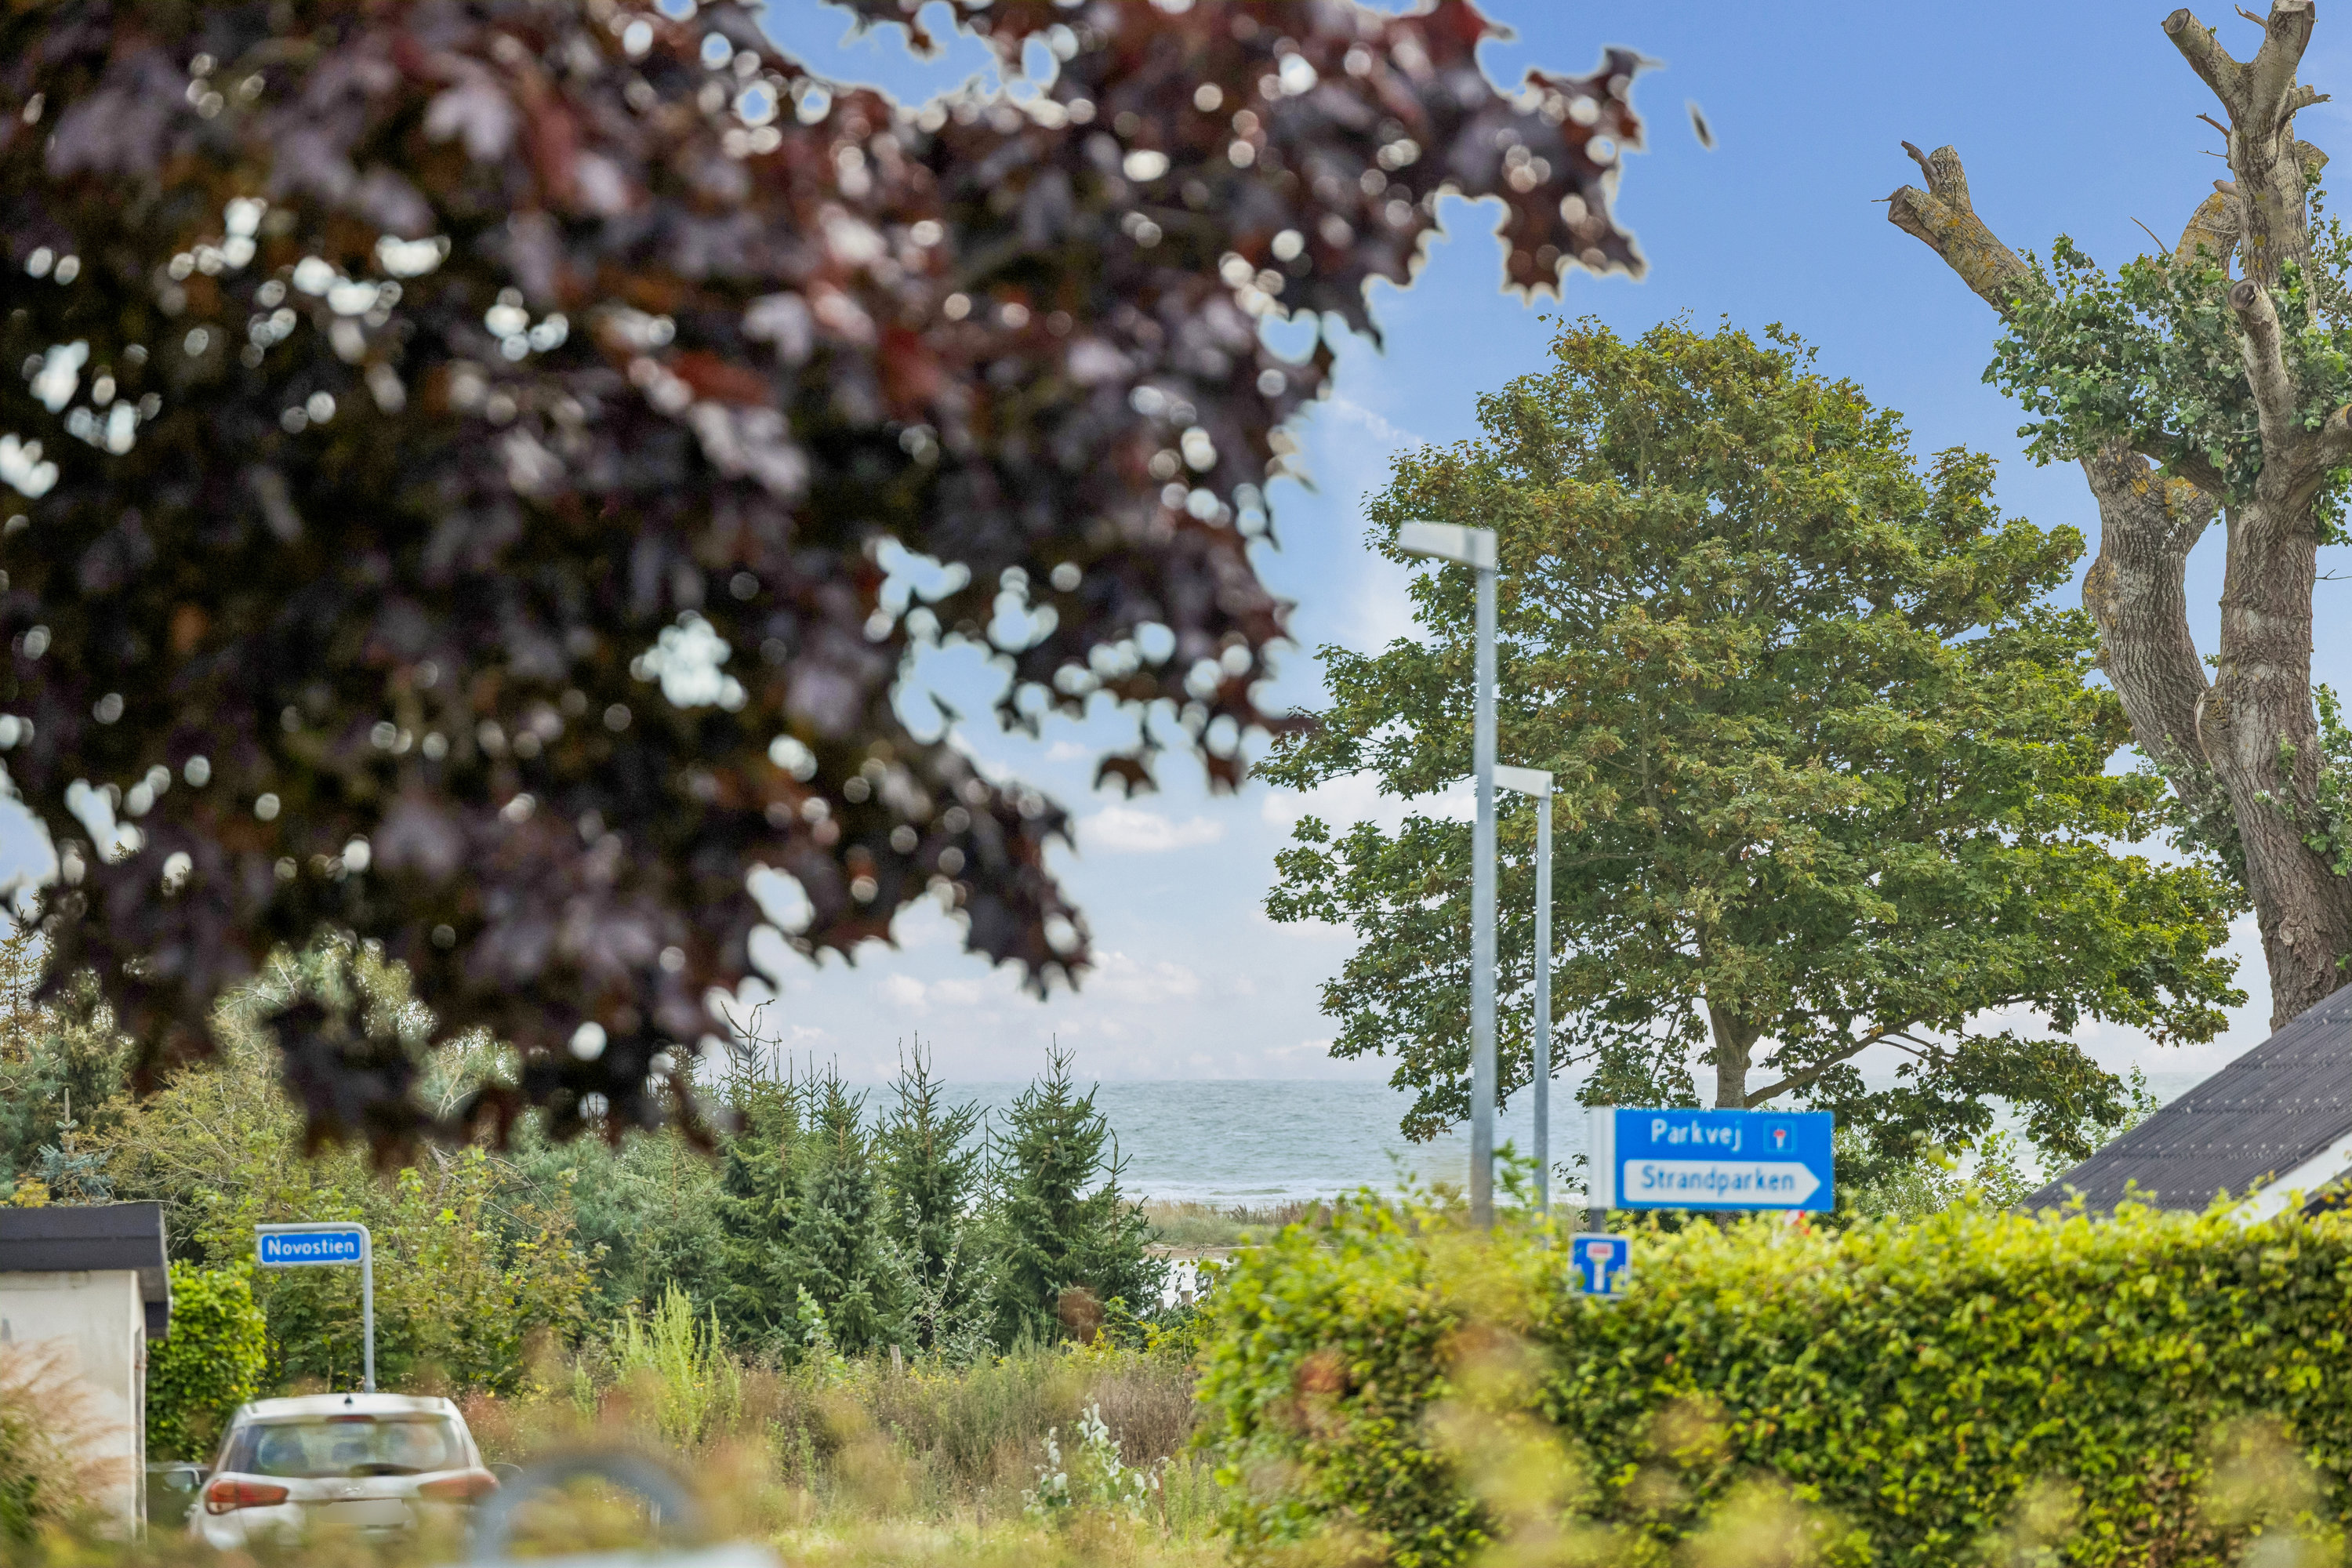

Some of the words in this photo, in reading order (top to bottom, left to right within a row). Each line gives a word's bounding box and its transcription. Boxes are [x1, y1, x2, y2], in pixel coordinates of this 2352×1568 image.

[1650, 1118, 1743, 1152] Parkvej
[1640, 1164, 1795, 1196] Strandparken
[267, 1238, 354, 1255] Novostien
